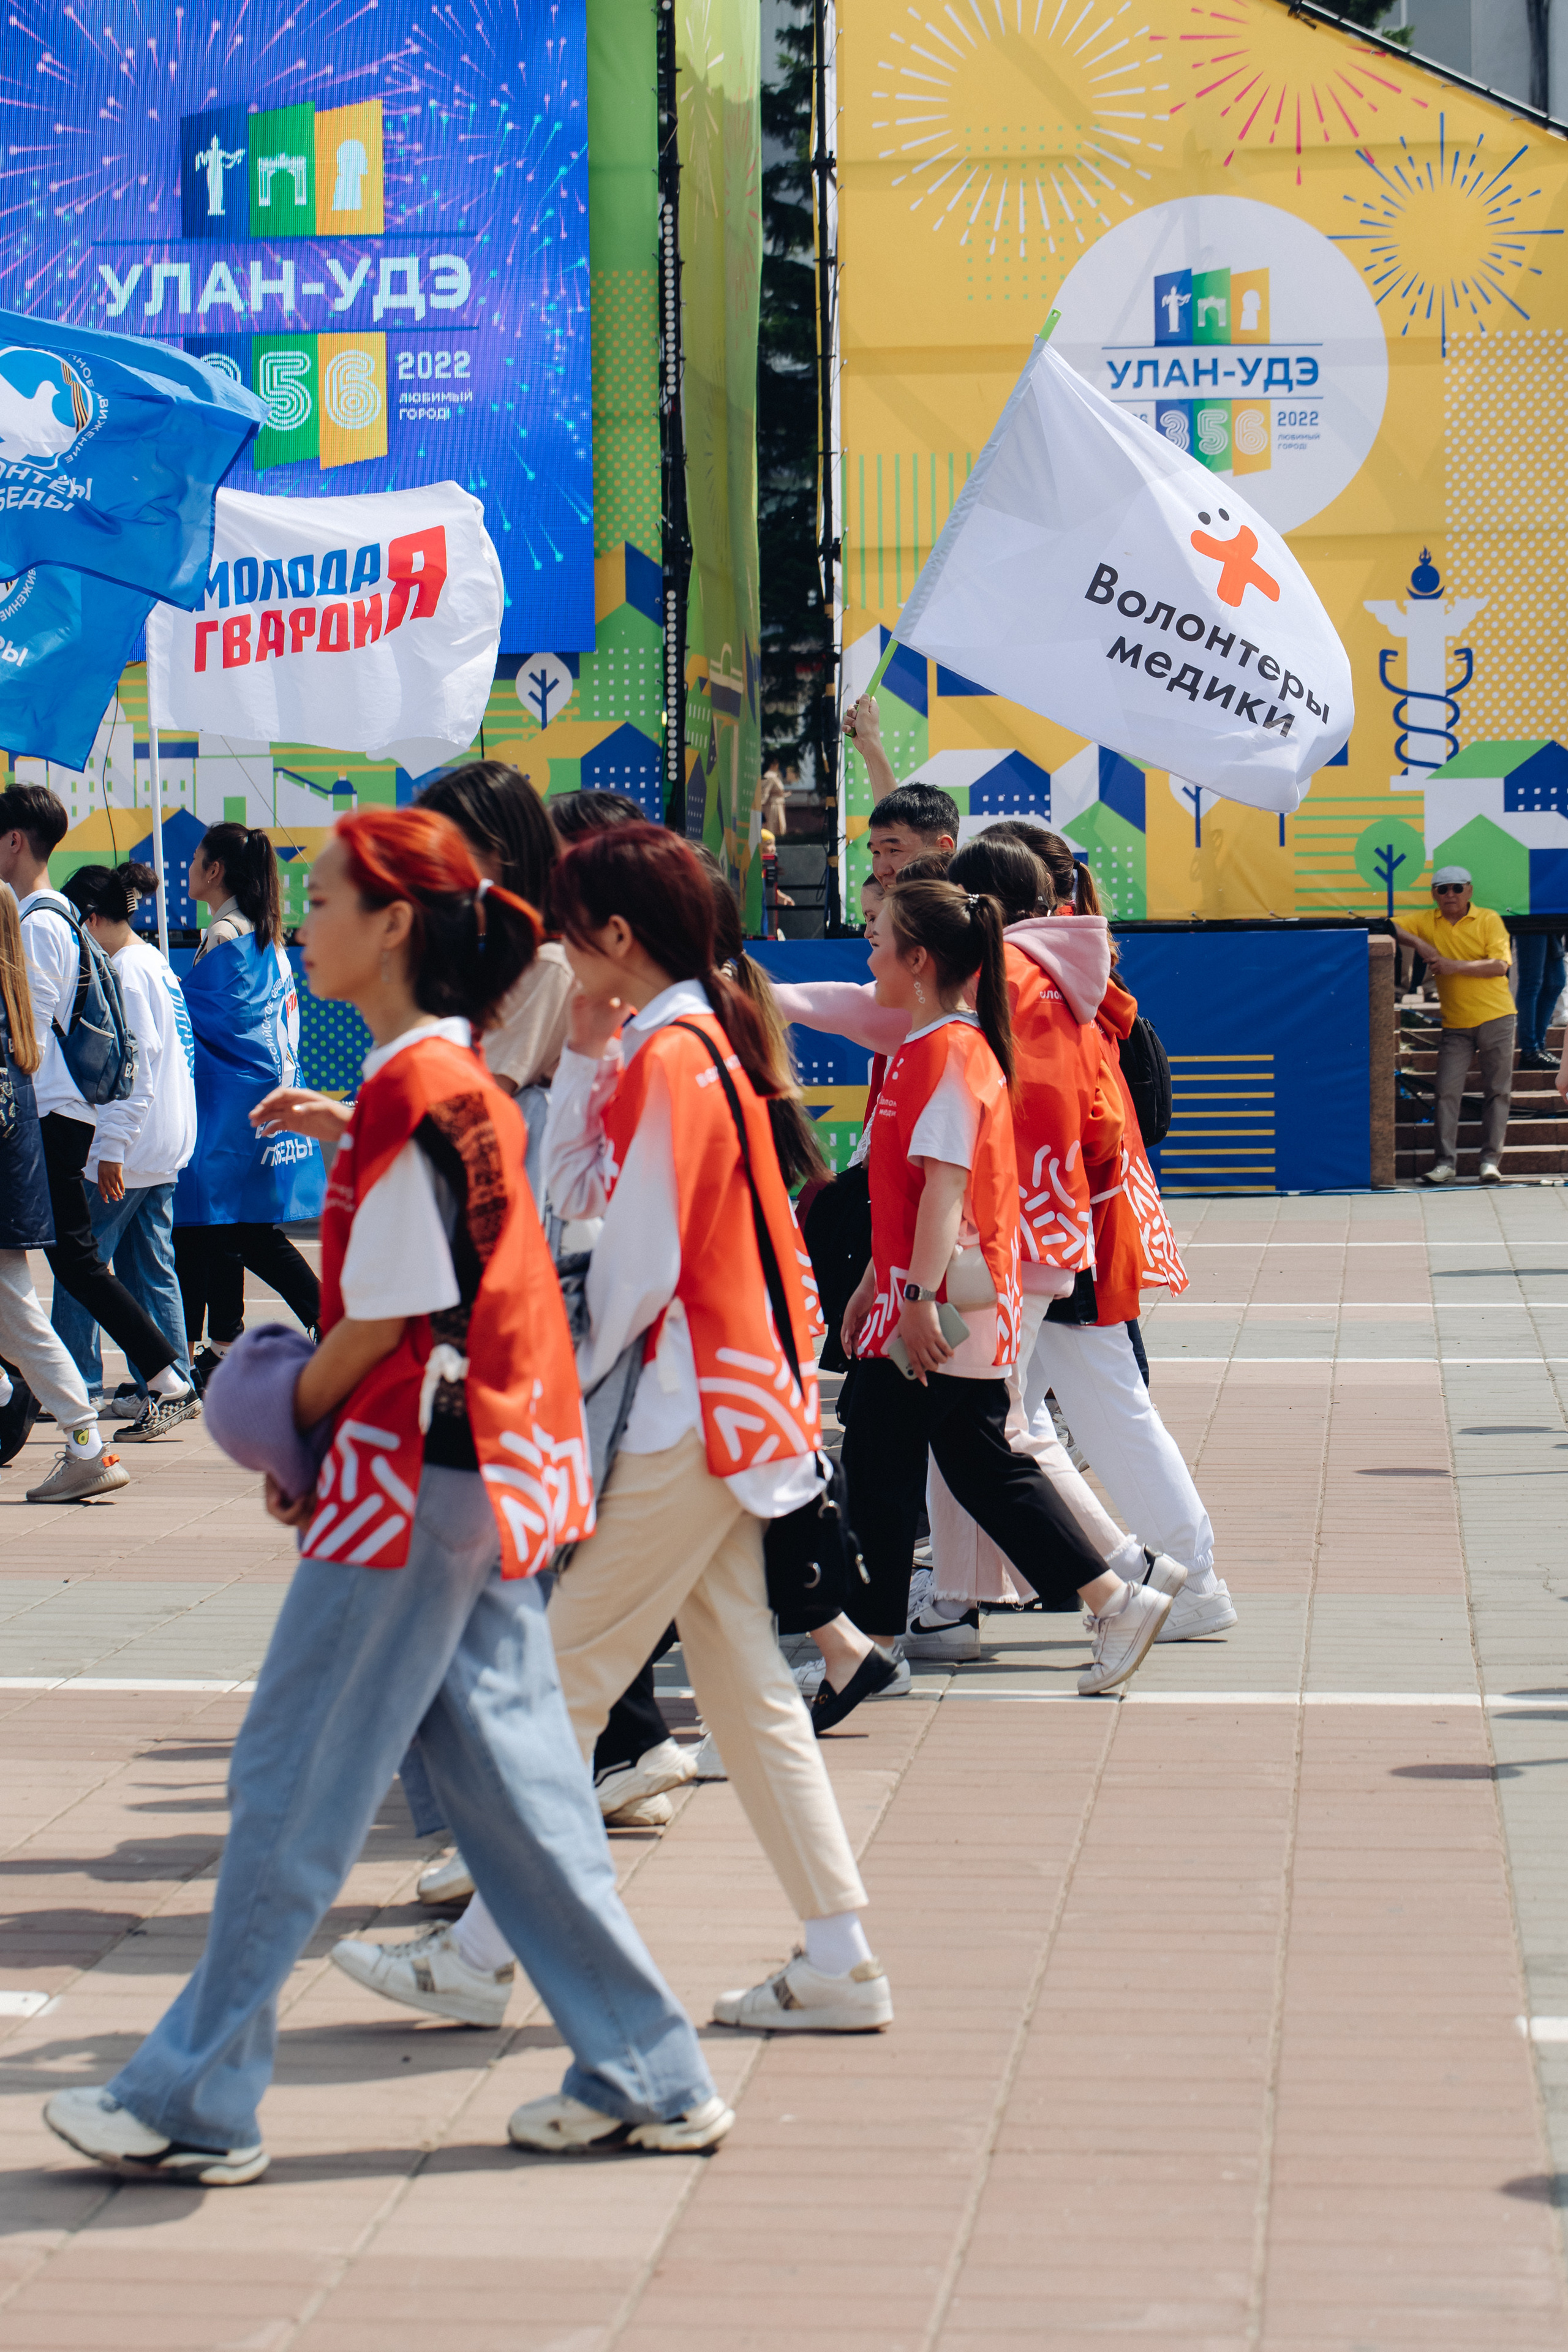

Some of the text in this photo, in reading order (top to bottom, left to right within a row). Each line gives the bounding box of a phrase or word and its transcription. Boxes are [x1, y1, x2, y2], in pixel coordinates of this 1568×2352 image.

[98, 254, 473, 323] УЛАН-УДЭ
[398, 350, 471, 380] 2022
[1106, 356, 1320, 393] УЛАН-УДЭ
[399, 388, 473, 404] ЛЮБИМЫЙ
[1278, 411, 1319, 426] 2022
[1084, 562, 1330, 725] Волонтеры
[1106, 635, 1295, 738] медики
